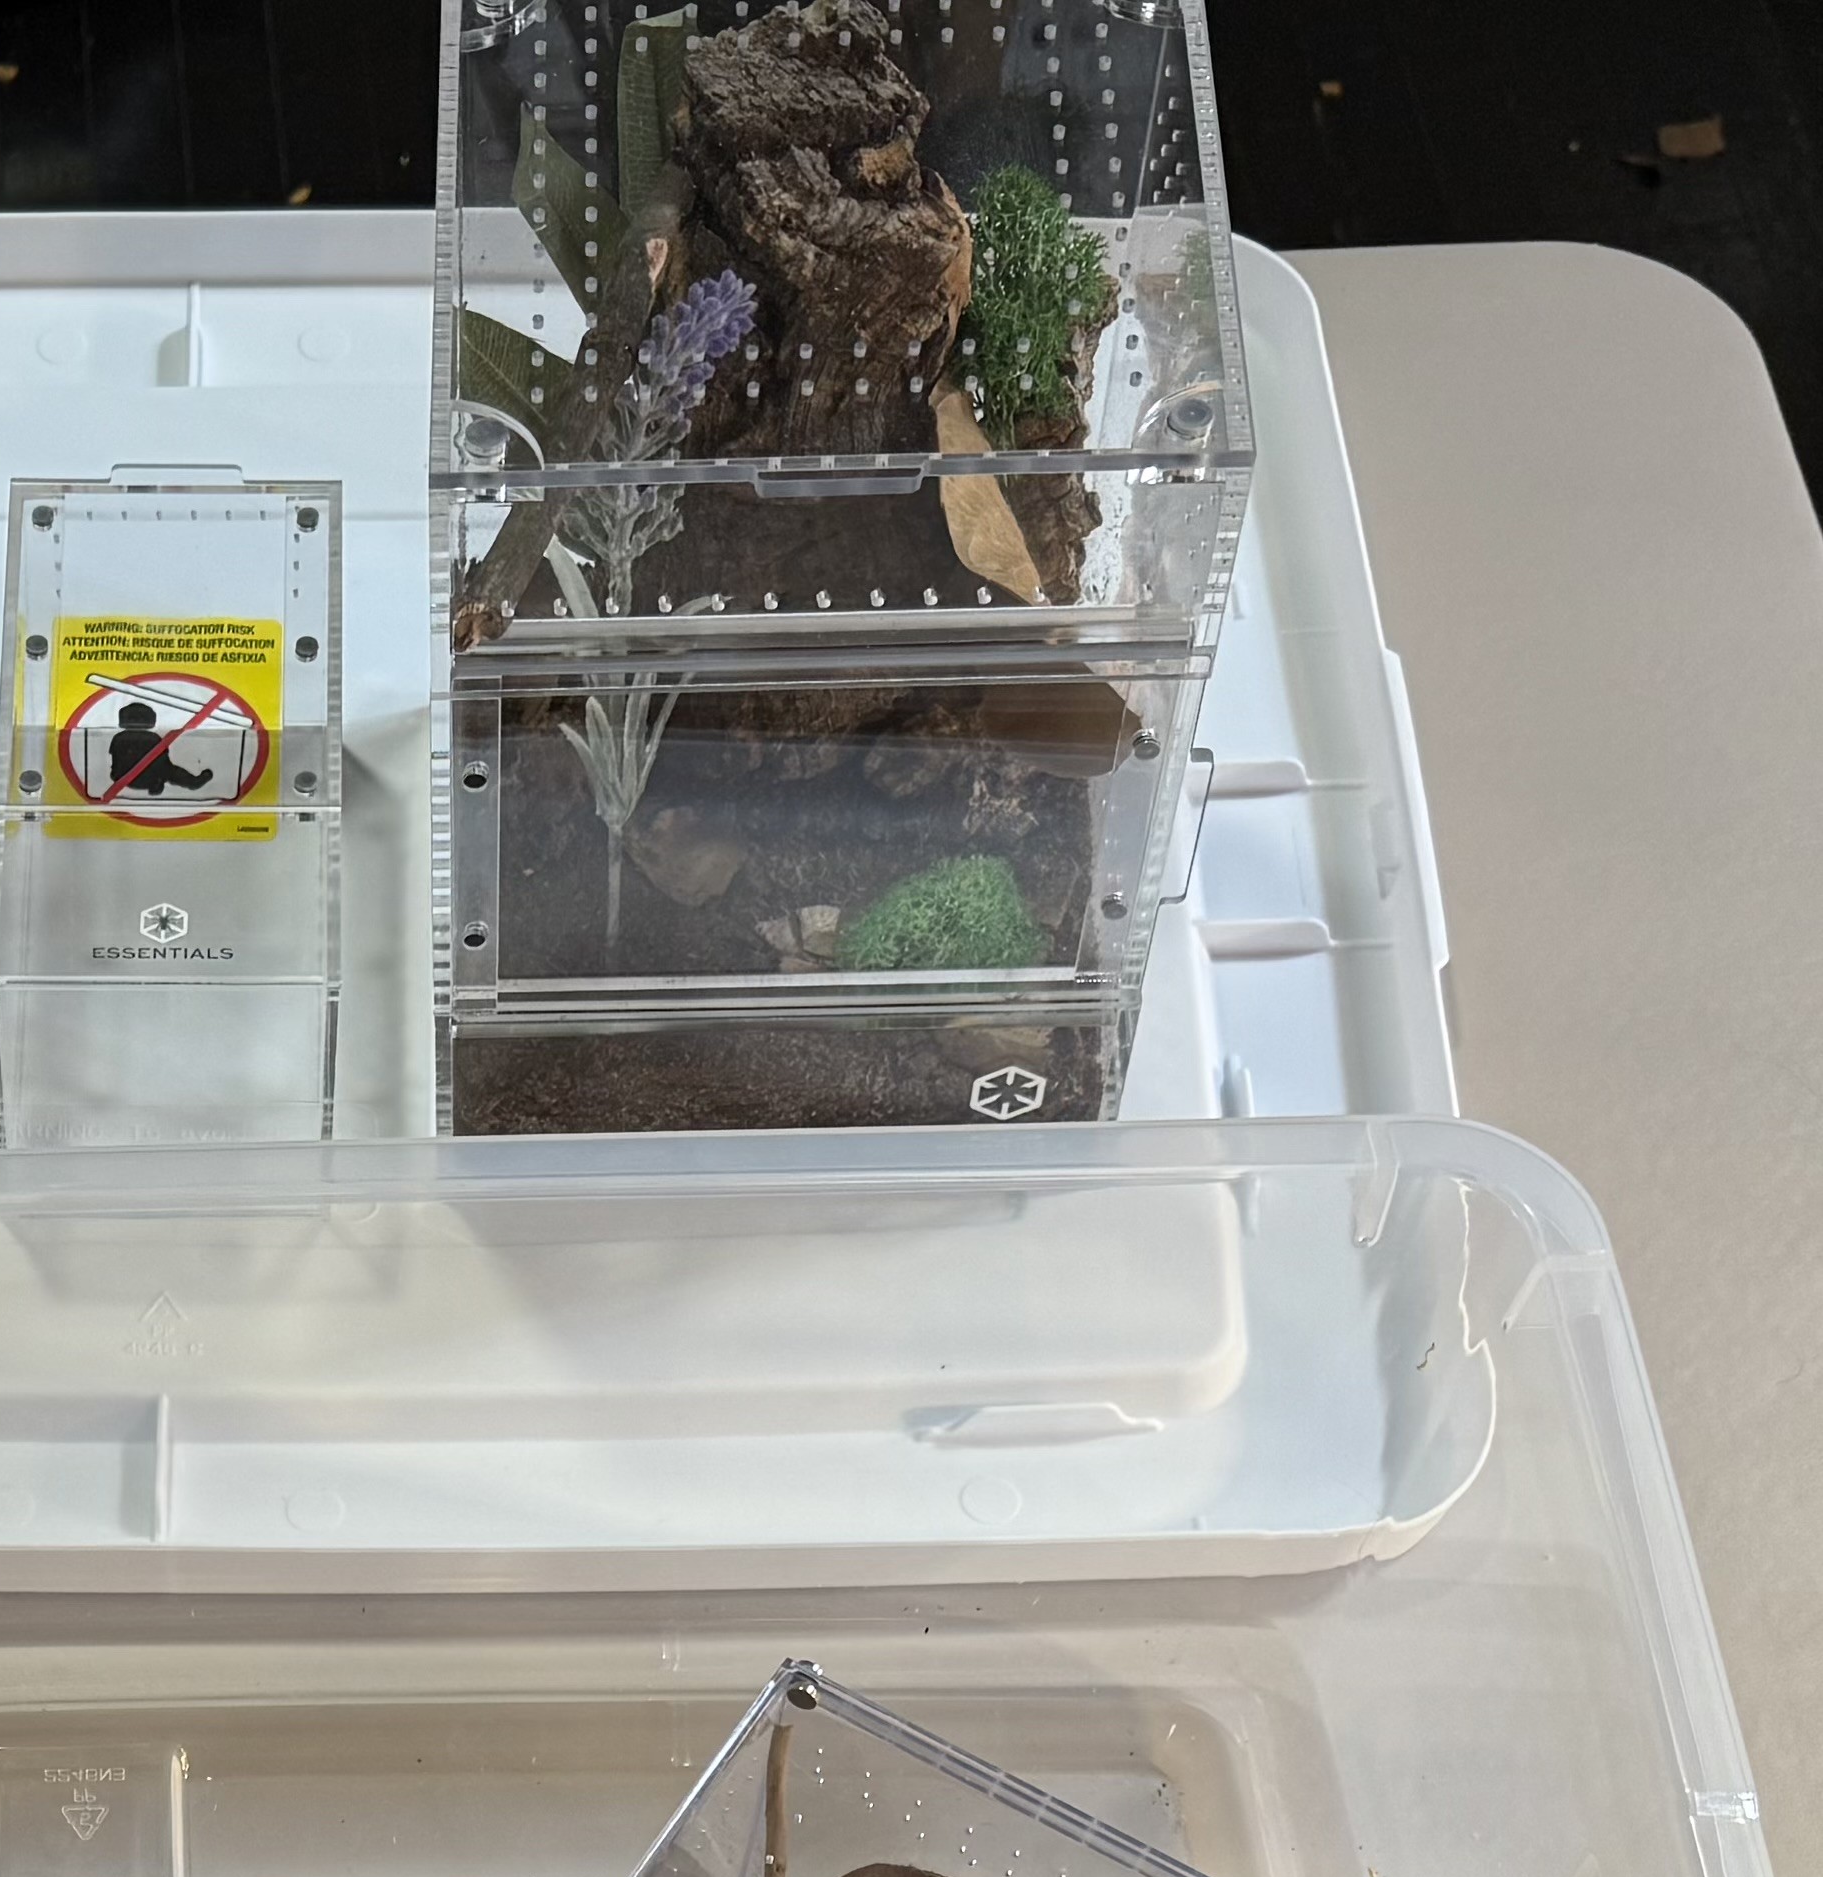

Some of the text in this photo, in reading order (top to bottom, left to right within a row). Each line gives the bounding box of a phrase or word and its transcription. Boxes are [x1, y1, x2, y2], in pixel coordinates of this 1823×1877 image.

[84, 622, 255, 635] WARNING: SUFFOCATION RISK
[62, 635, 275, 649] ATTENTION: RISQUE DE SUFFOCATION
[70, 649, 267, 663] ADVERTENCIA: RIESGO DE ASFIXIA
[92, 947, 235, 960] ESSENTIALS
